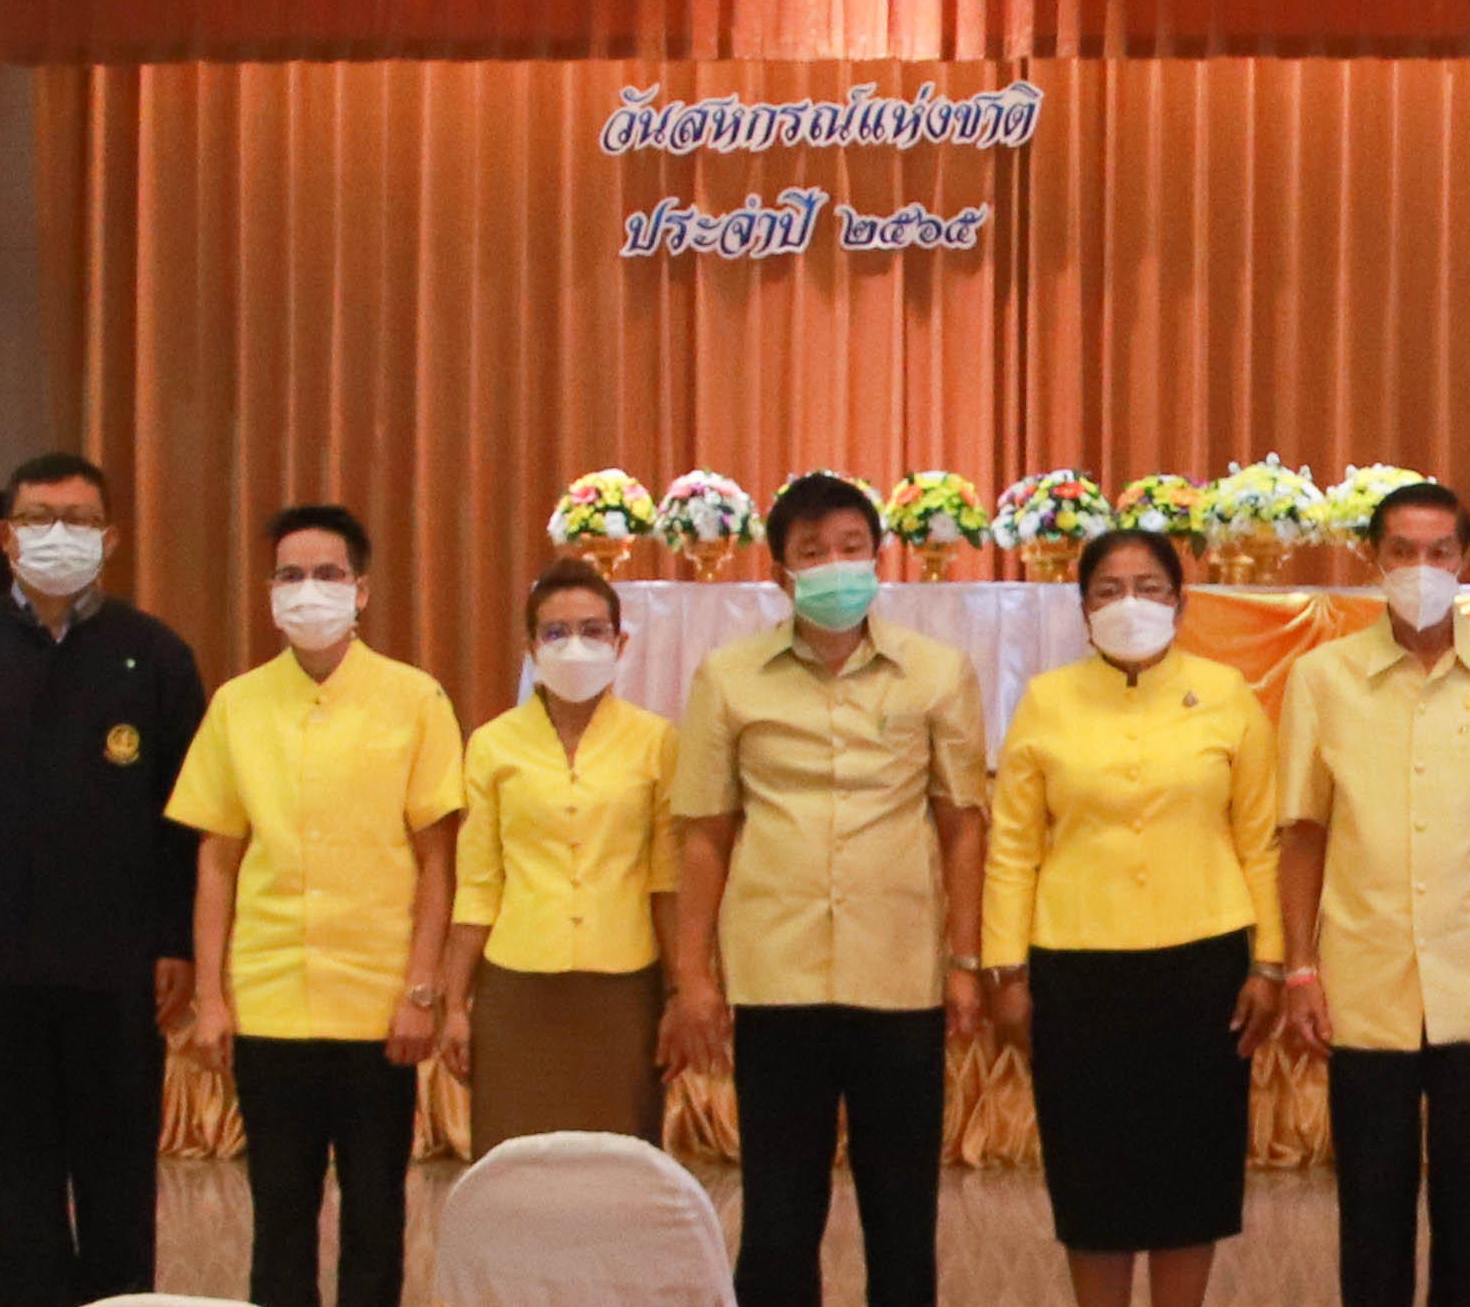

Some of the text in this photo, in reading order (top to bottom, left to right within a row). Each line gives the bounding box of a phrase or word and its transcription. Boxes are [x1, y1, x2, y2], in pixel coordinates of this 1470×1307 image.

[602, 81, 1042, 153] วันสหกรณ์แห่งชาติ
[624, 189, 986, 256] ประจำปี ๒๕๖๕
